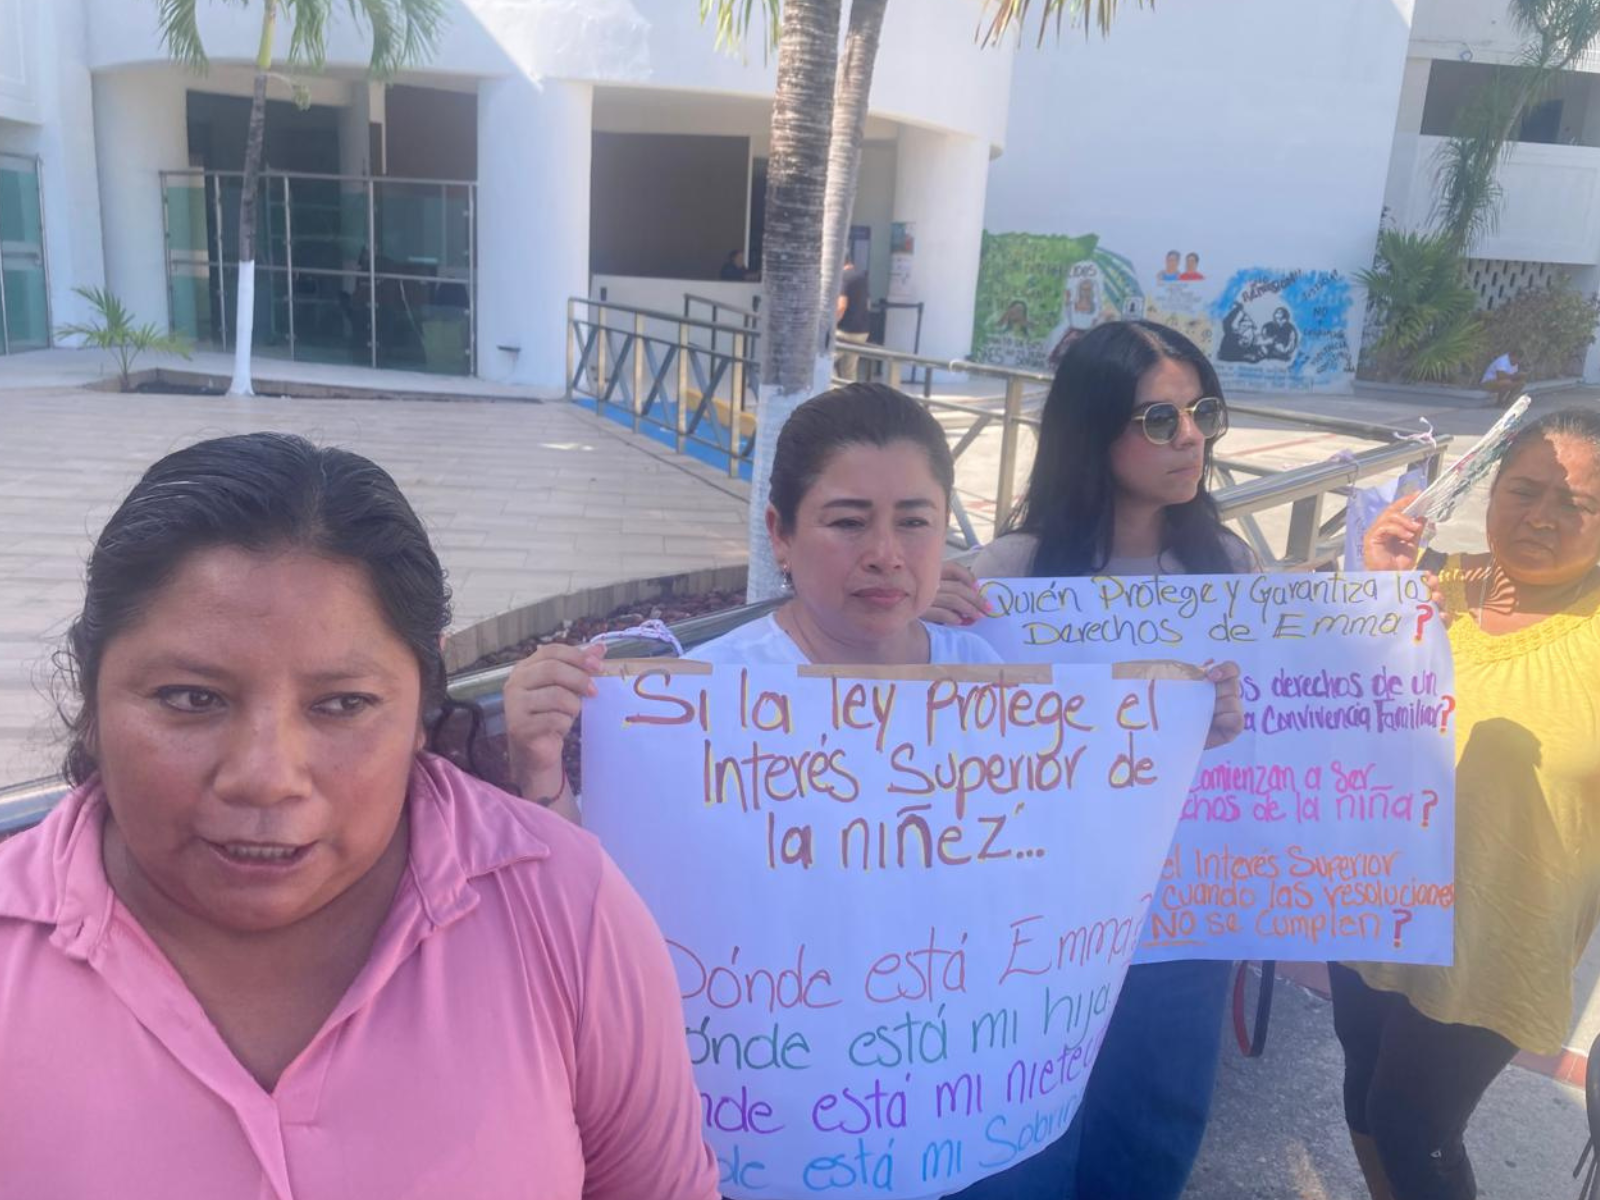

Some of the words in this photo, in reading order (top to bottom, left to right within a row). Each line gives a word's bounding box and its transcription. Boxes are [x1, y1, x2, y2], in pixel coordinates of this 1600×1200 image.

[978, 581, 1082, 618] Quién
[1091, 575, 1218, 618] Protege
[1225, 579, 1240, 618] y
[1250, 572, 1377, 623] Garantiza
[1397, 575, 1433, 603] los
[1208, 612, 1258, 642] de
[1271, 667, 1364, 700] derechos
[1372, 666, 1403, 700] de
[1411, 669, 1438, 697] un
[740, 667, 794, 735] la
[831, 674, 896, 751] ley
[1116, 678, 1158, 732] el
[1261, 704, 1371, 736] Convivencia
[703, 733, 860, 813] Interés
[888, 742, 1087, 820] Superior
[1107, 731, 1158, 789] de
[1304, 766, 1321, 791] a
[1253, 793, 1287, 822] de
[1296, 791, 1320, 824] la
[768, 811, 813, 869] la
[1287, 845, 1403, 883] Superior
[1268, 879, 1315, 910] las
[1151, 909, 1197, 940] NO
[664, 938, 843, 1013] Dónde
[865, 925, 967, 1003] está
[685, 1015, 812, 1071] ónde
[849, 1002, 948, 1068] está
[972, 1007, 1018, 1054] mi
[700, 1086, 786, 1135] nde
[811, 1072, 909, 1135] está
[936, 1073, 983, 1119] mi
[803, 1137, 896, 1193] está
[922, 1138, 962, 1183] mi
